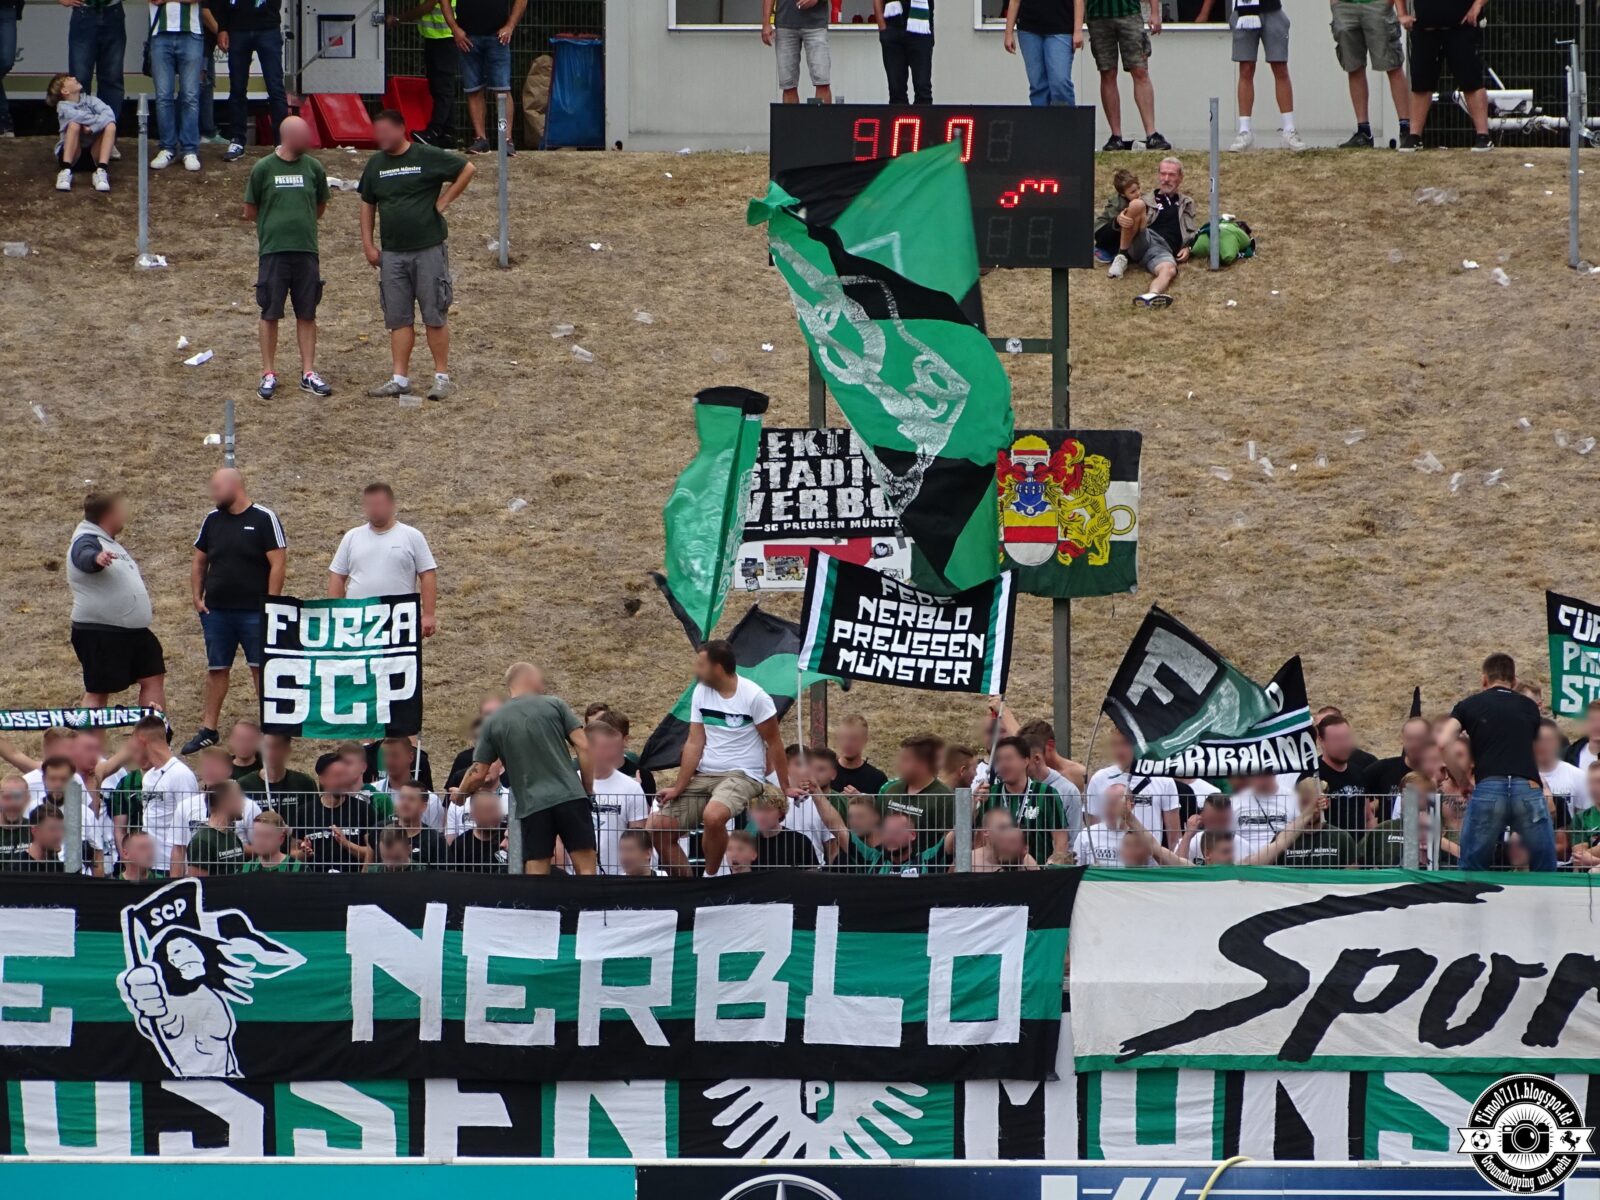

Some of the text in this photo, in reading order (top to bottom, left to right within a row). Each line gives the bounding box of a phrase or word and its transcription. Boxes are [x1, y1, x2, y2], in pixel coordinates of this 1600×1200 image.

[746, 486, 899, 522] VERBO
[784, 520, 845, 530] PREUSSEN
[850, 518, 904, 528] MÜNSTE
[264, 601, 417, 648] FORZA
[857, 595, 973, 631] NERBLO
[832, 618, 985, 659] PREUSSEN
[836, 647, 973, 686] MÜNSTER
[263, 655, 418, 724] SCP
[150, 898, 187, 926] SCP
[346, 902, 1029, 1047] NERBLO
